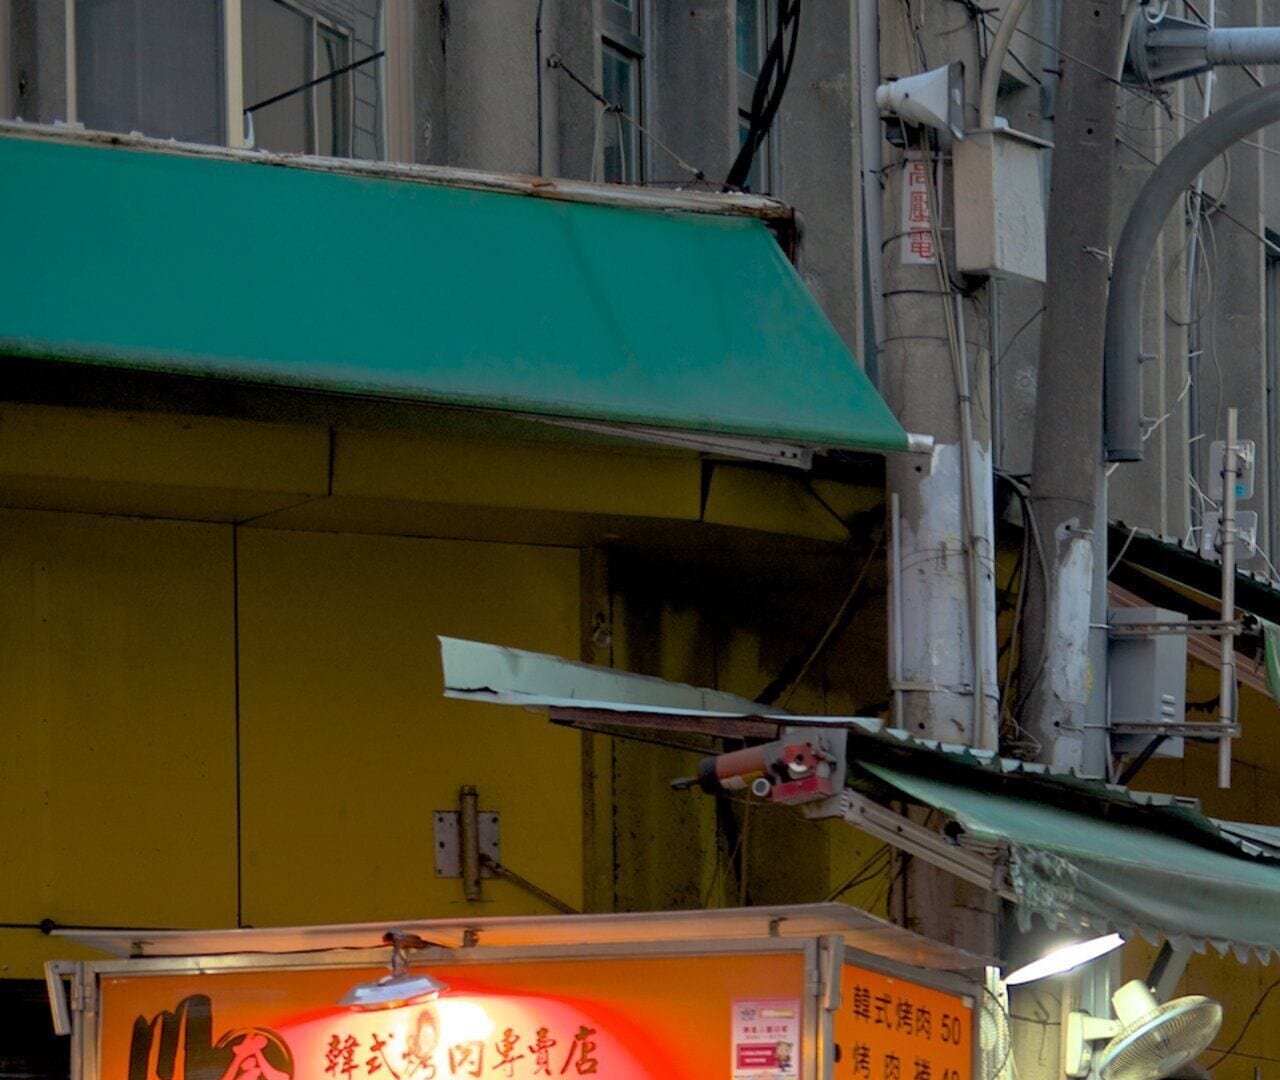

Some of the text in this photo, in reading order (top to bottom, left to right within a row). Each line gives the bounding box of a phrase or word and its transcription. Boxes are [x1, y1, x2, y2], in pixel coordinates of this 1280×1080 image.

[852, 985, 961, 1046] 韓式烤肉 50
